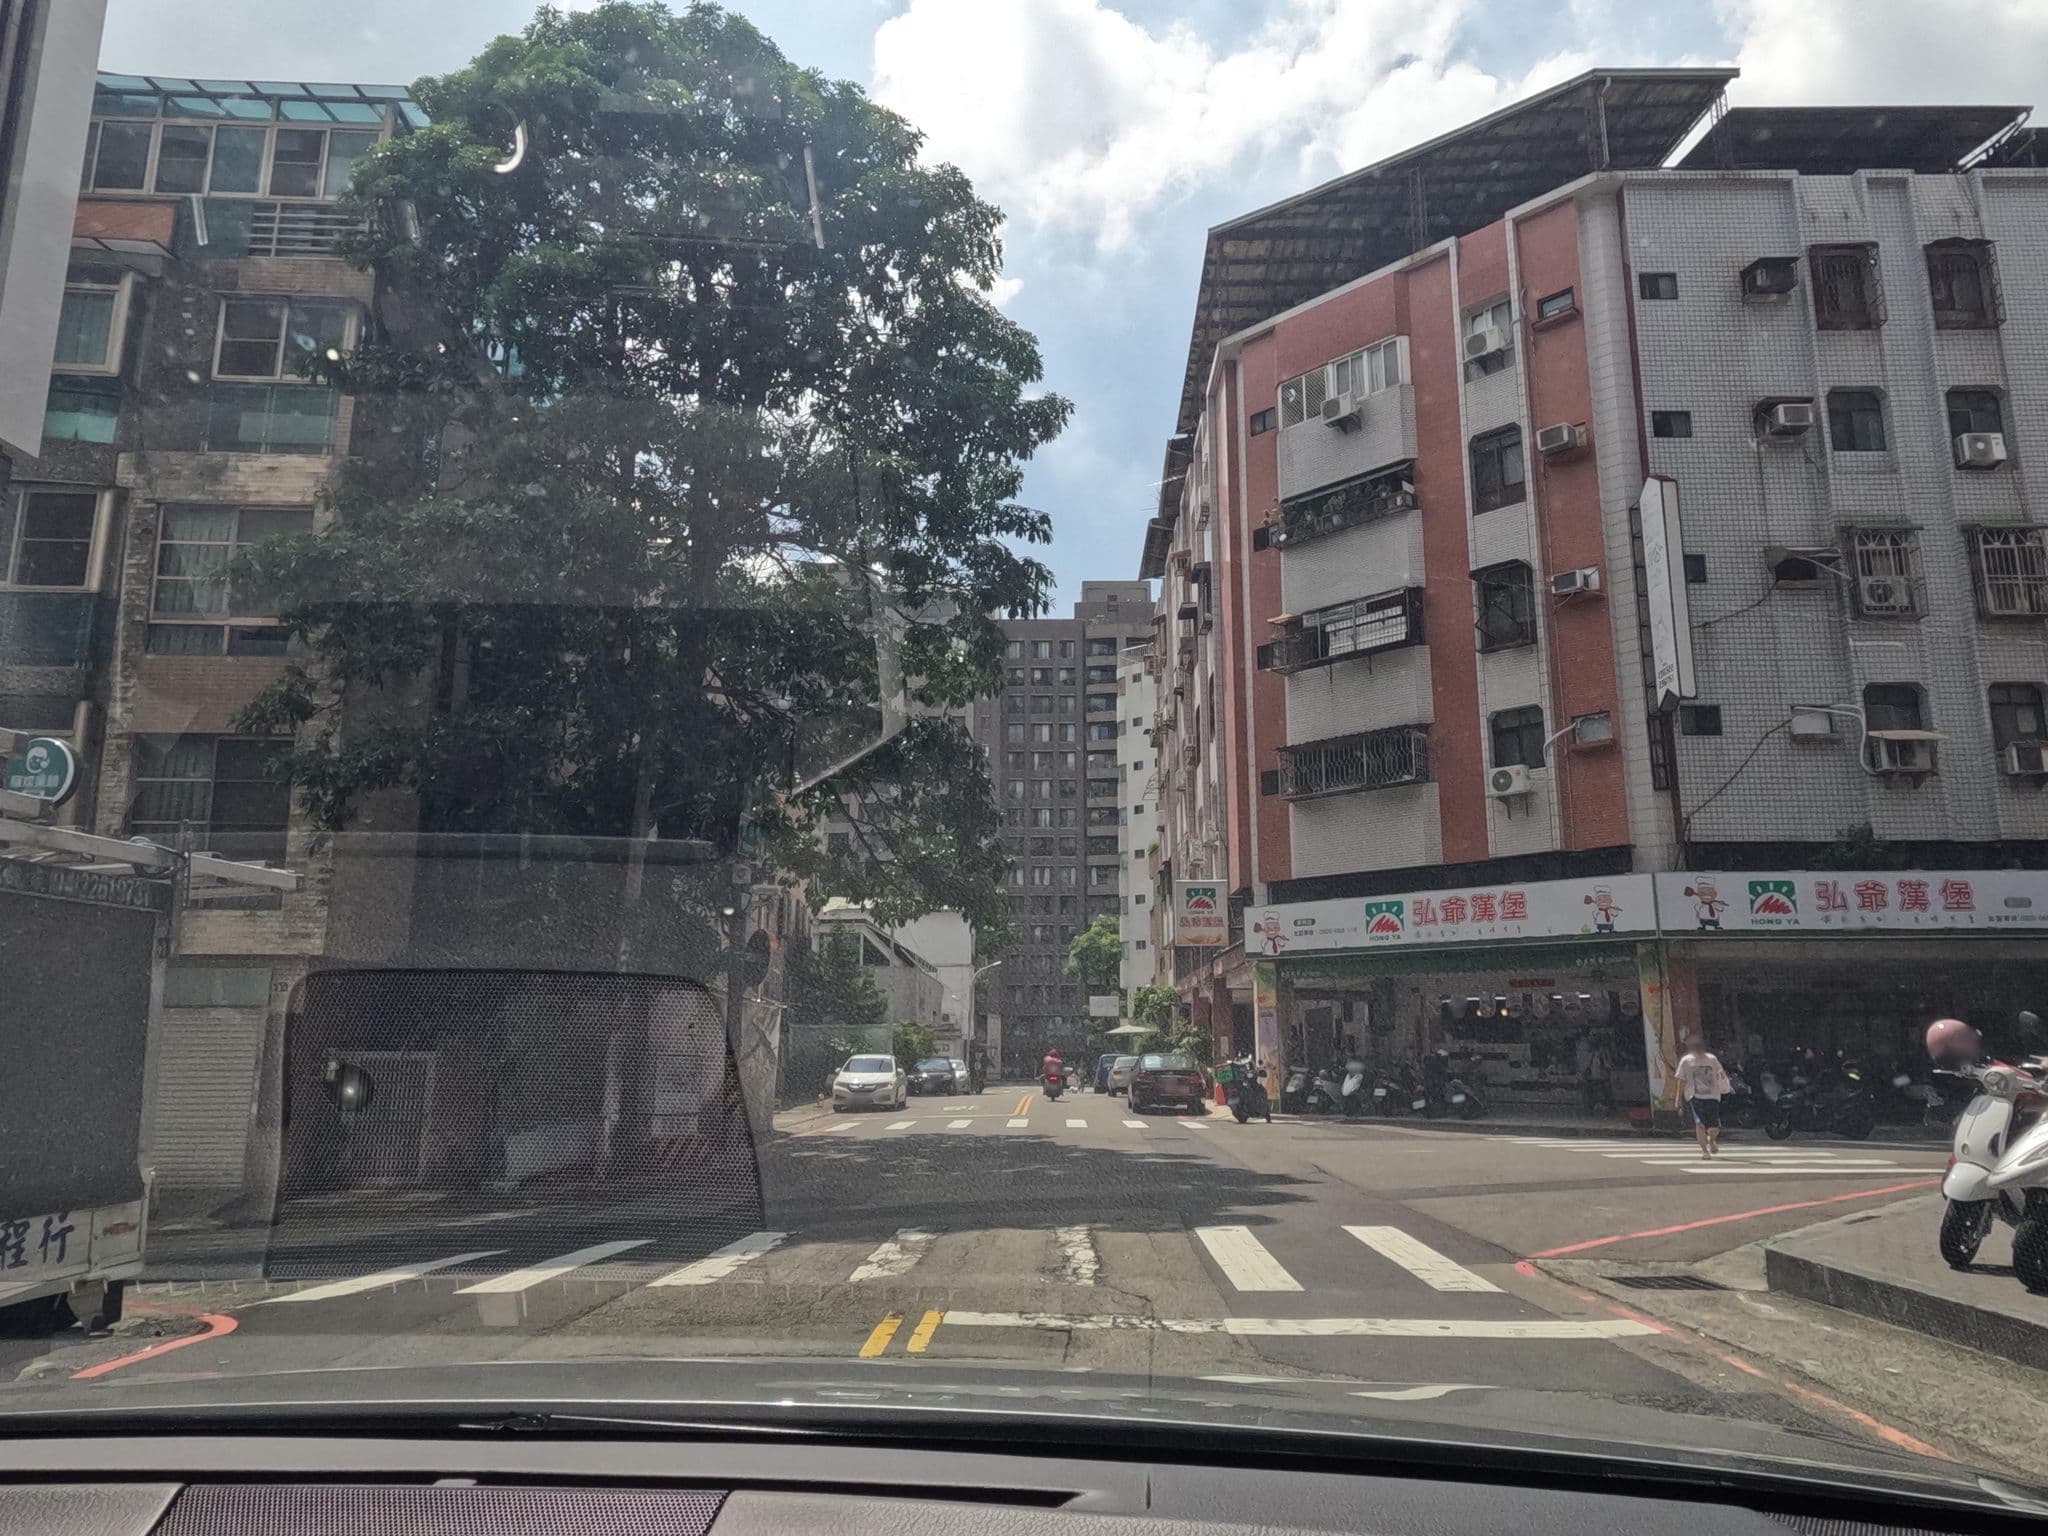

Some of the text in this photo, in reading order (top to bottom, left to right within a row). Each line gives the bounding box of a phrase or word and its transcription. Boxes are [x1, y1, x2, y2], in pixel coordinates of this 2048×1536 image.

[1814, 879, 1976, 912] 弘爺漢堡
[1412, 890, 1528, 926] 弘爺漢堡
[1751, 918, 1801, 926] HONG YA
[1368, 934, 1390, 942] HONG
